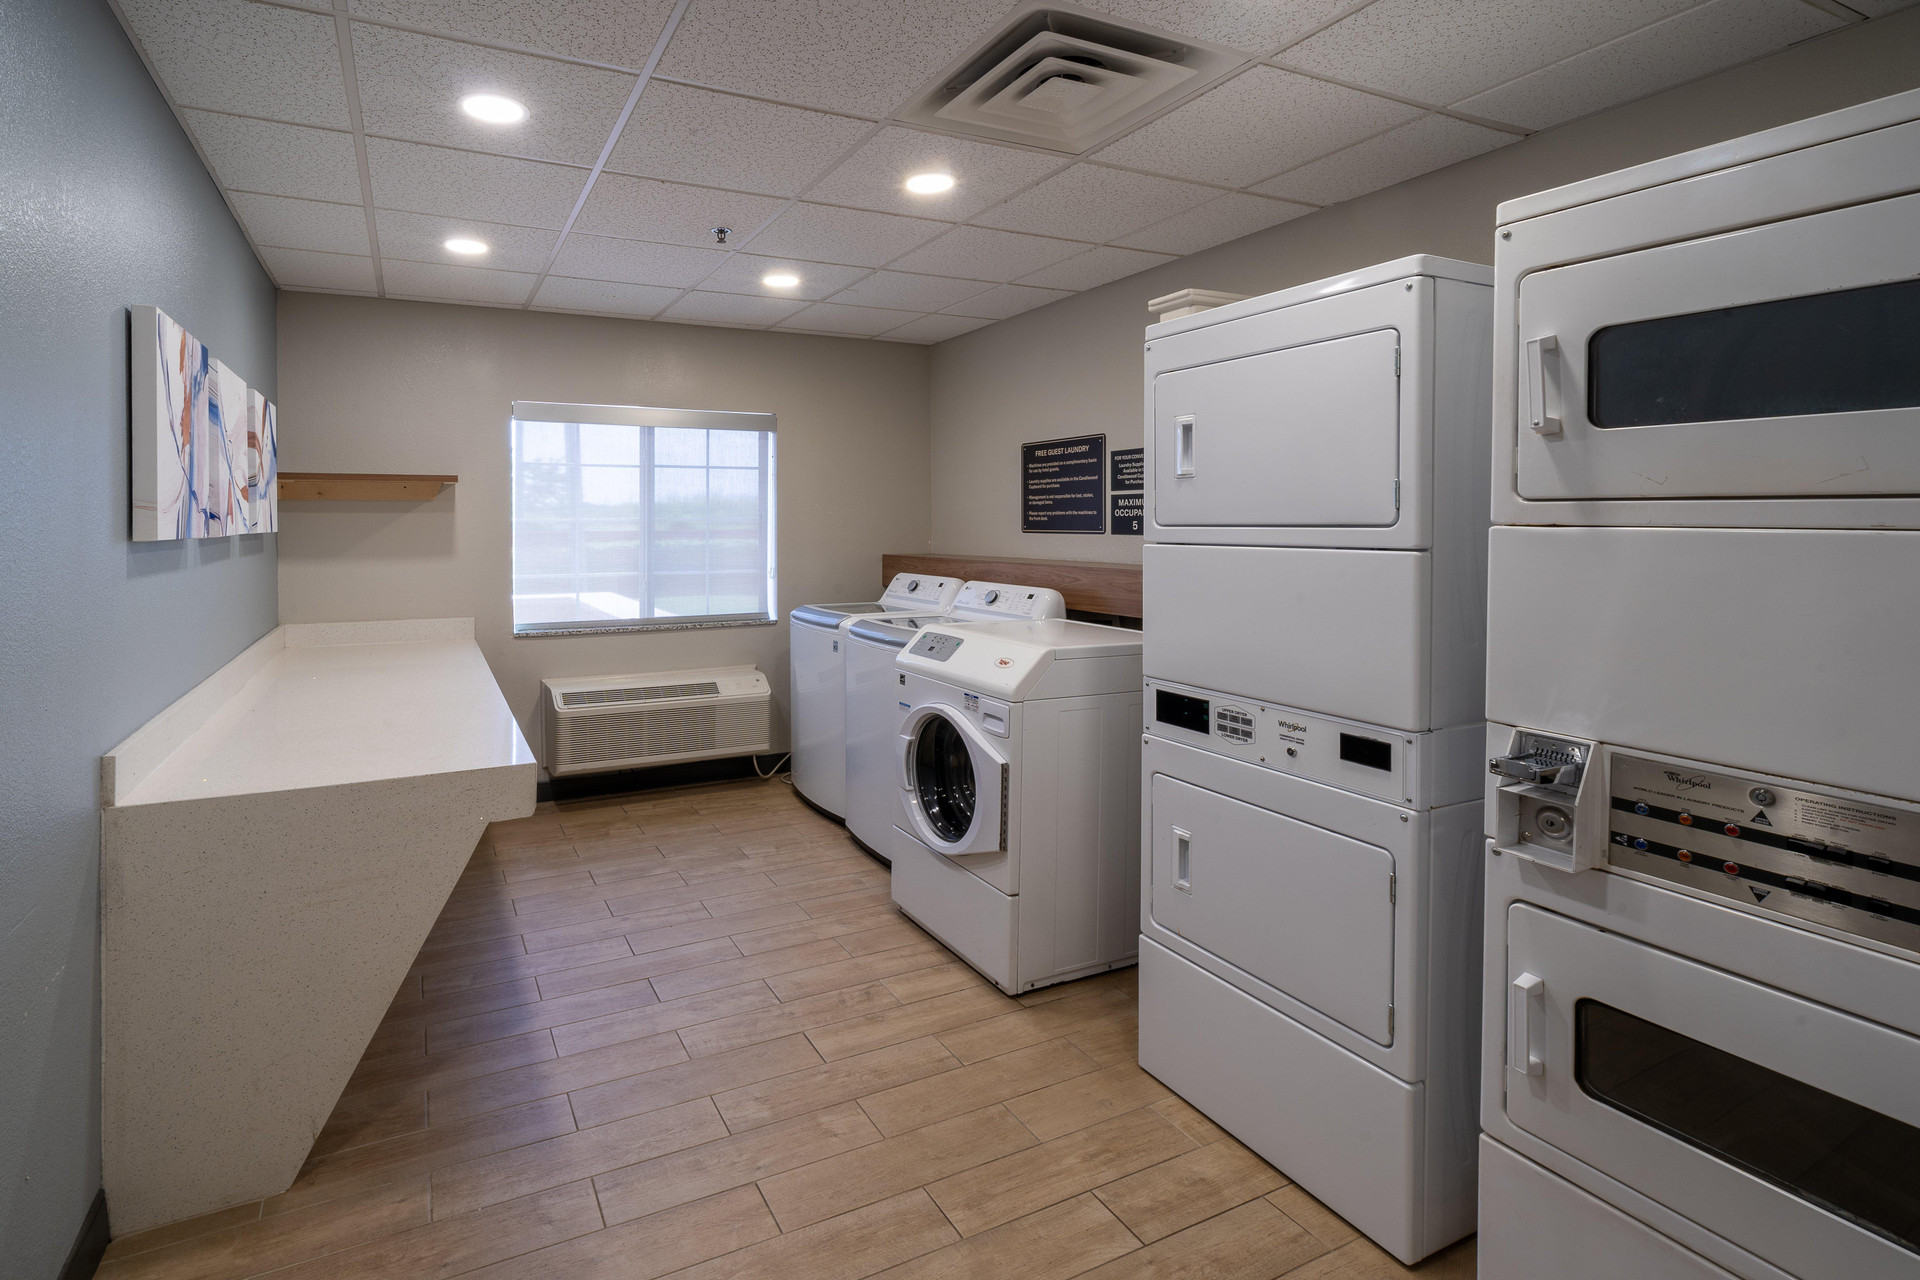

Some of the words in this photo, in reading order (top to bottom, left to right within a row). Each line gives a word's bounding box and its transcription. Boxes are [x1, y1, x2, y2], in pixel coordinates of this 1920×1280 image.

[1065, 445, 1089, 453] LAUNDRY
[1133, 521, 1138, 530] 5
[1278, 720, 1307, 733] Whirlpool
[1666, 774, 1712, 790] Whirlpool
[1683, 796, 1711, 806] LAUNDRY
[1712, 803, 1745, 814] PRODUCTS
[1794, 797, 1836, 809] OPERATING
[1839, 805, 1896, 820] INSTRUCTIONS
